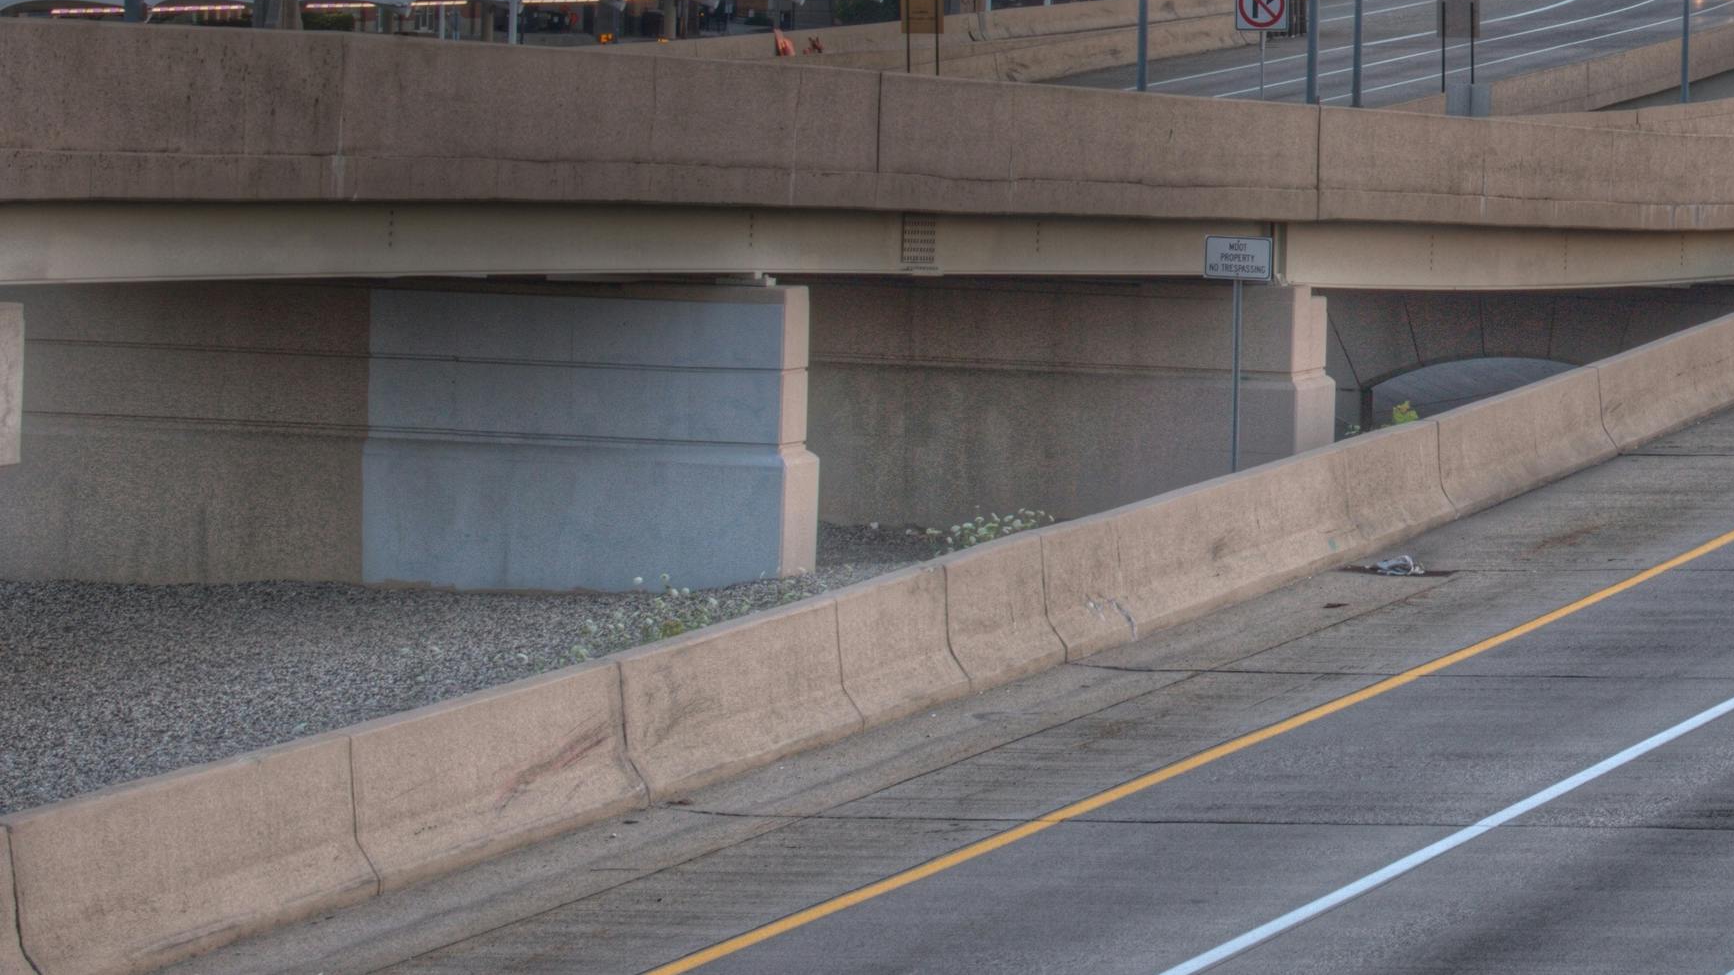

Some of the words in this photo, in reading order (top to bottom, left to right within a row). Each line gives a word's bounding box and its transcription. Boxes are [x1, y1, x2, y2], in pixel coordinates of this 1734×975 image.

[1228, 242, 1247, 251] MDOT
[1220, 252, 1255, 263] PROPERTY
[1209, 263, 1219, 273] NO
[1221, 264, 1266, 274] TRESPASSING
